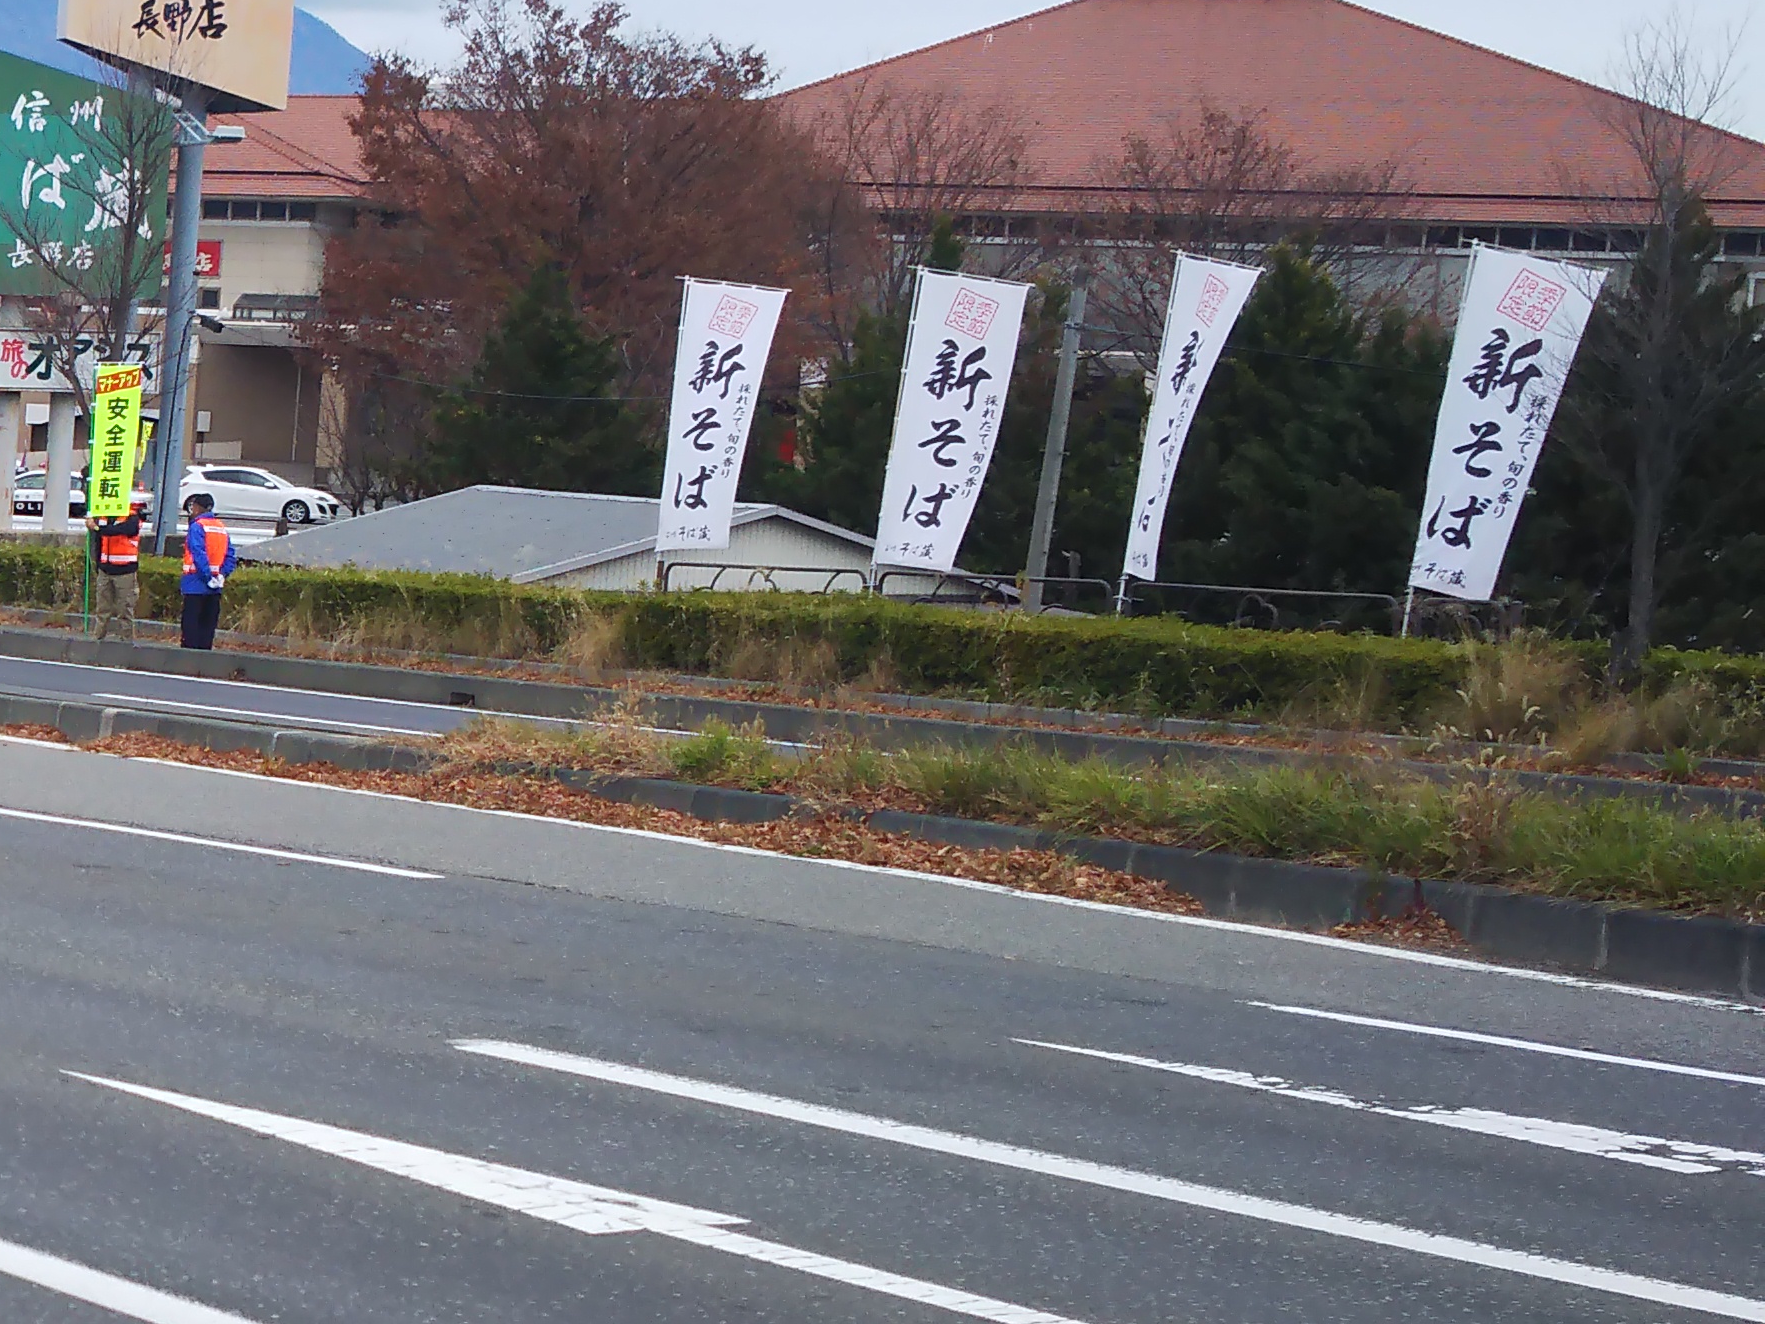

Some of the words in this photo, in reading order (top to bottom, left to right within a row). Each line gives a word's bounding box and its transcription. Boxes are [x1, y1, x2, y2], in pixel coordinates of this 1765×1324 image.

[10, 90, 104, 133] 信州
[98, 397, 130, 500] 安全運転
[672, 340, 746, 510] 新そば
[917, 338, 994, 529] 新そば
[1426, 327, 1545, 550] 新そば
